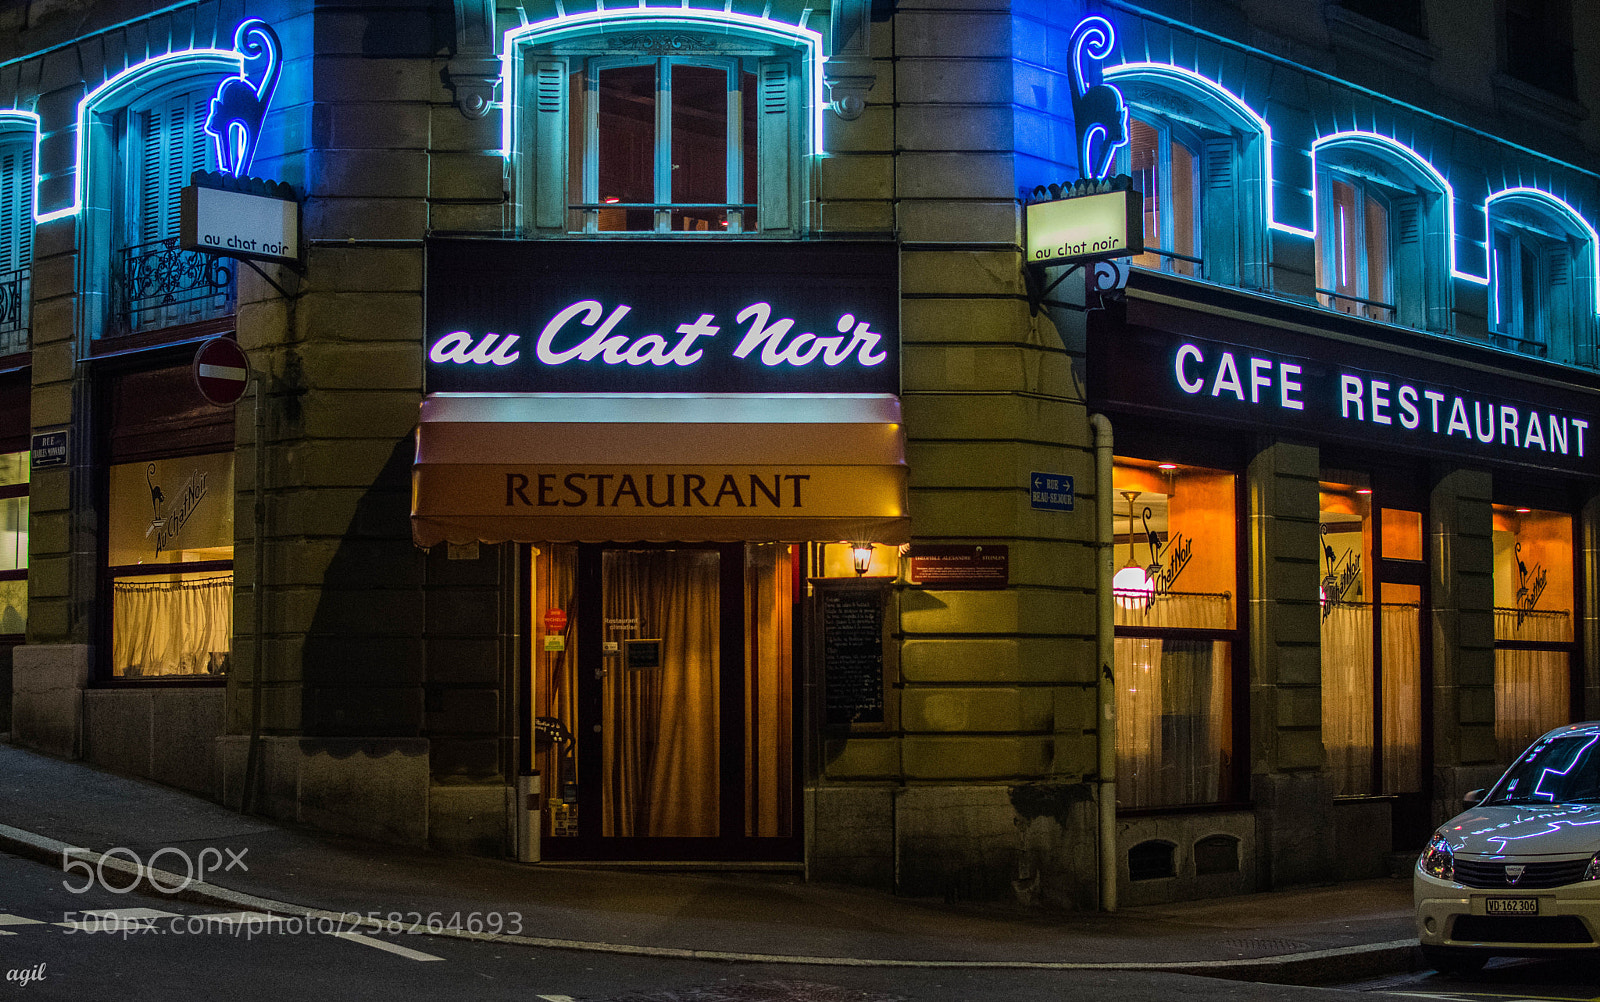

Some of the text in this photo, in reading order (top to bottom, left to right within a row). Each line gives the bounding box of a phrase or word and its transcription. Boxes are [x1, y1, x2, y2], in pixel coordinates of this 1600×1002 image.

[204, 234, 289, 255] au chat noir
[1035, 236, 1119, 259] au chat noir
[429, 299, 887, 367] au Chat Noir
[1174, 343, 1589, 457] CAFE RESTAURANT
[42, 436, 55, 447] RUE
[504, 473, 811, 508] RESTAURANT
[1046, 478, 1059, 491] RUE
[1519, 900, 1535, 911] 306
